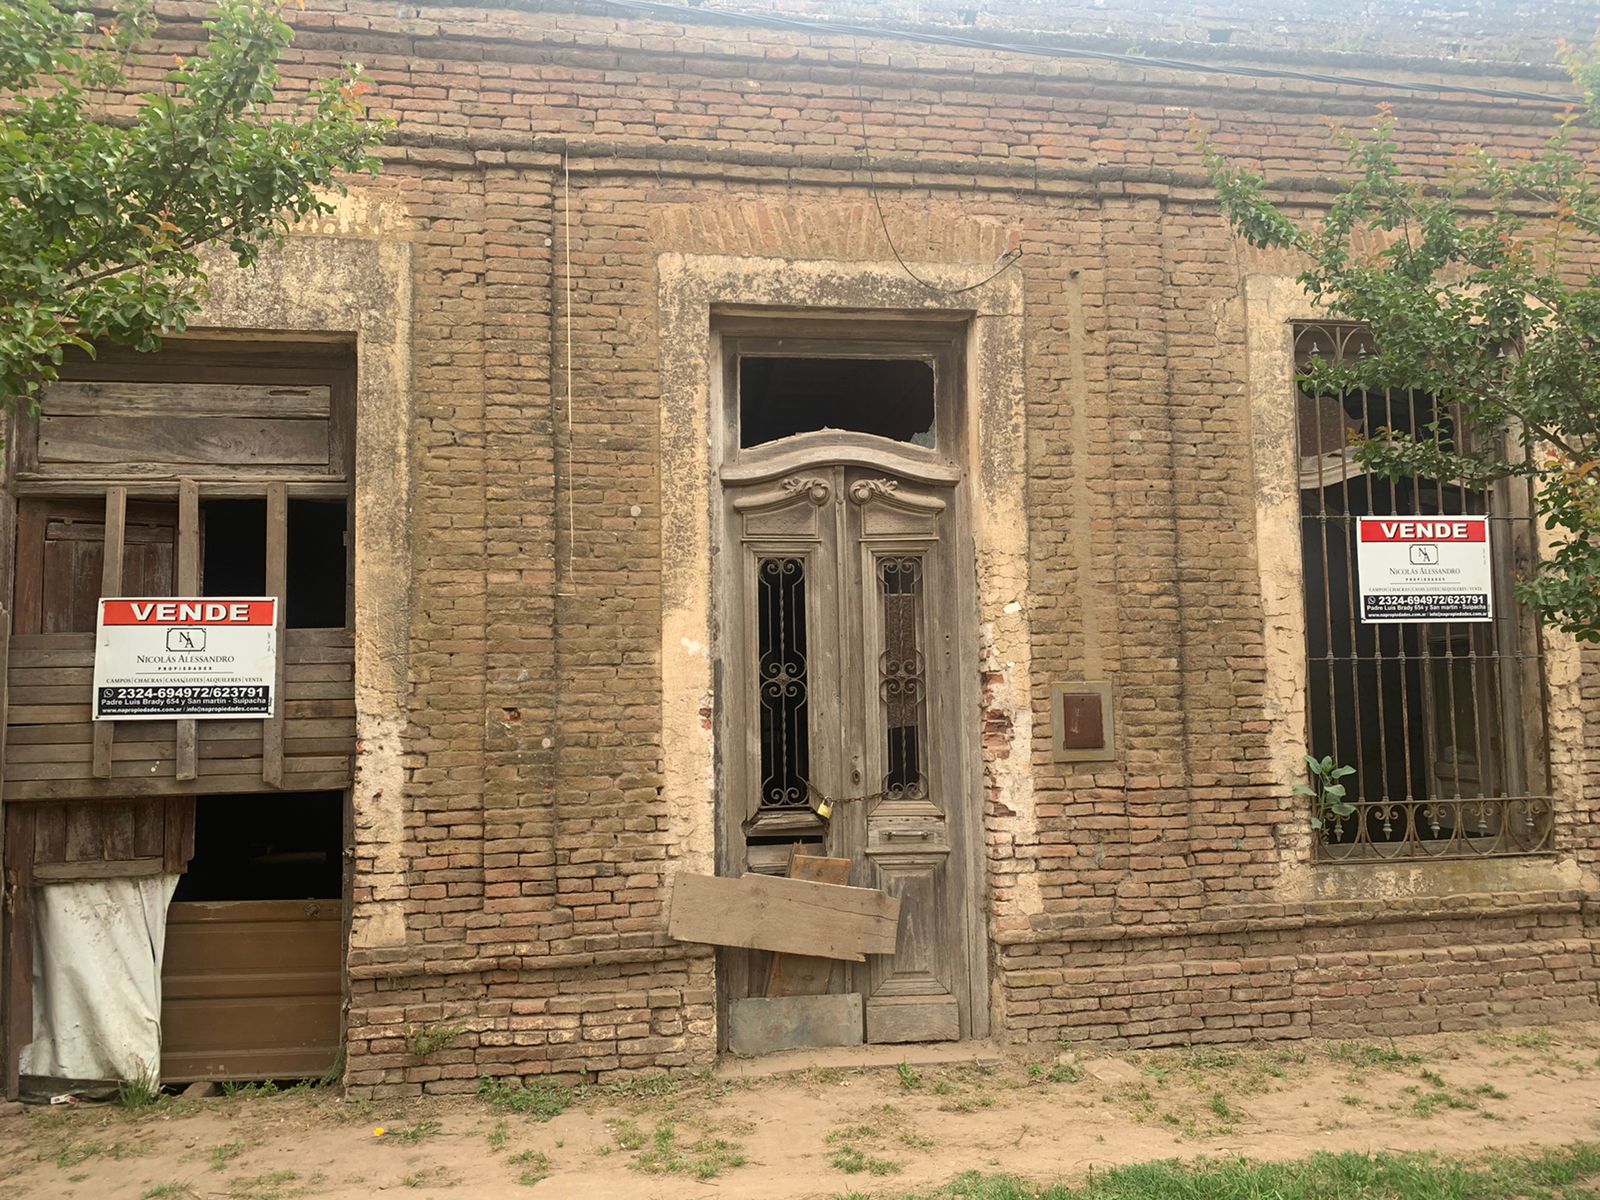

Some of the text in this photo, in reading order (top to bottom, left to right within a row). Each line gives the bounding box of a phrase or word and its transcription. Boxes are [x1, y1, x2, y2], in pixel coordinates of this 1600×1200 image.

[1380, 523, 1469, 539] VENDE
[1420, 566, 1461, 575] ALESSANDRO
[1378, 595, 1484, 605] 2324-694972/623791
[130, 603, 250, 622] VENDE
[177, 654, 235, 663] ALESSANDRO
[117, 687, 264, 699] 2324-694972/623791
[142, 699, 165, 707] Brady
[165, 698, 180, 706] 654
[232, 697, 267, 705] Suipacha
[102, 706, 182, 714] www.napropiedades.com.ar
